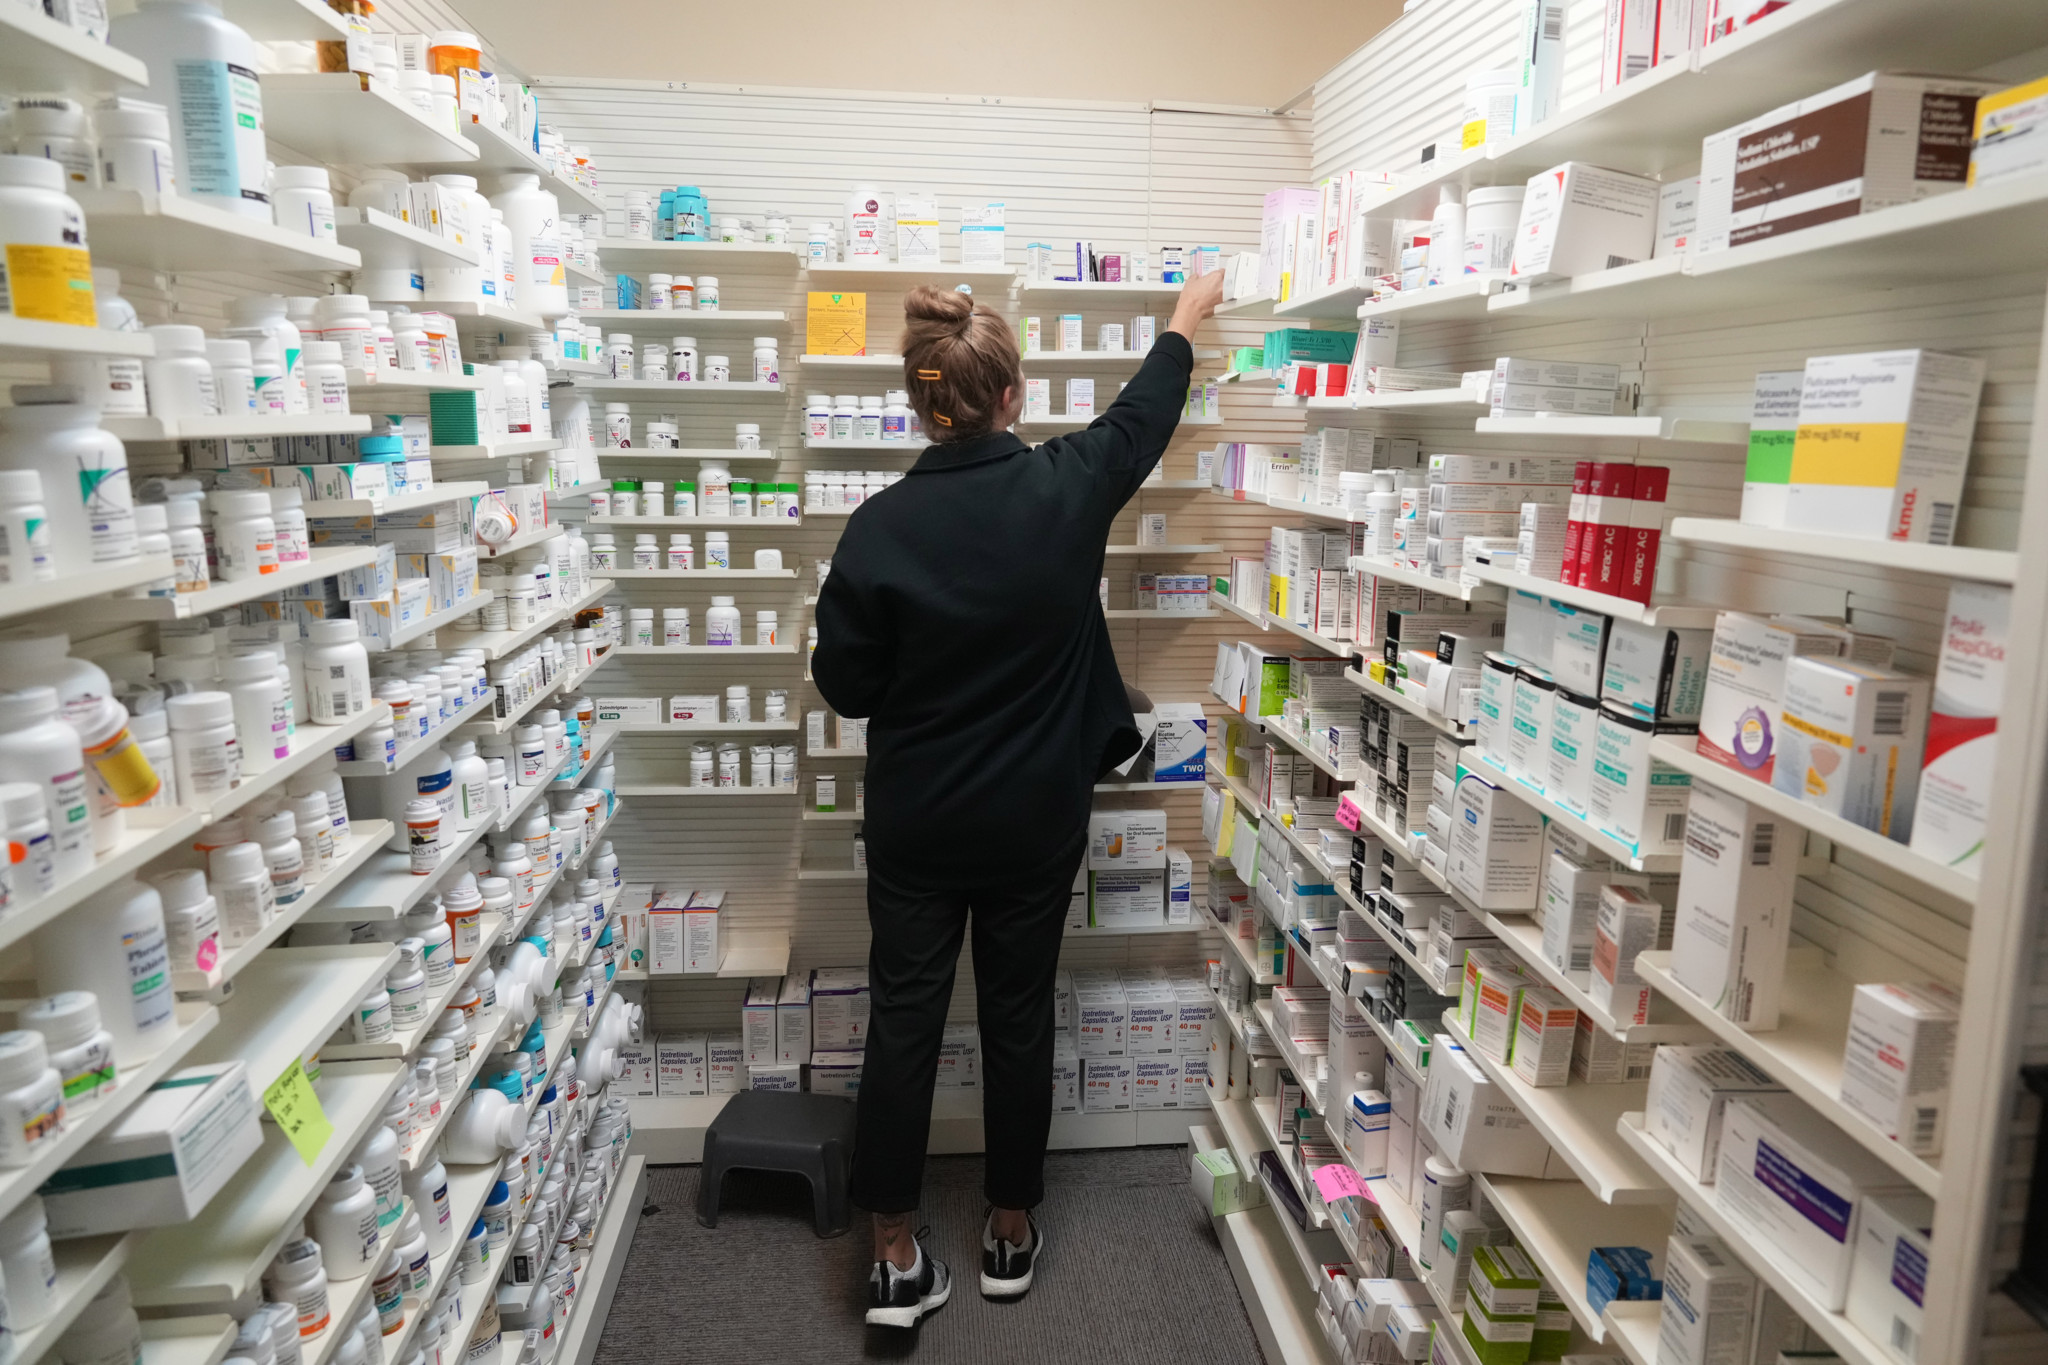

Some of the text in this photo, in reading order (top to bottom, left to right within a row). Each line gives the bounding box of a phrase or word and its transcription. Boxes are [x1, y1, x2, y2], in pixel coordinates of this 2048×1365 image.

[1801, 136, 1820, 153] USP
[1806, 374, 1896, 387] Fluticasone Propionate
[1756, 390, 1789, 398] Fluticasone
[1804, 389, 1860, 399] and Salmeterol
[1755, 400, 1799, 410] and Salmeterol
[1844, 430, 1861, 442] mcg
[1891, 488, 1918, 542] kma.
[1605, 528, 1616, 544] AC
[1637, 532, 1648, 548] AC
[1674, 656, 1692, 714] Albuterol
[1686, 671, 1701, 715] Sulfate
[1131, 1015, 1159, 1023] Capsules,
[639, 1057, 652, 1065] USP
[1088, 1064, 1121, 1072] Isotretinoin
[1137, 1068, 1178, 1077] Capsules, USP
[752, 1082, 781, 1090] Capsules,
[470, 1340, 496, 1358] XFORD
